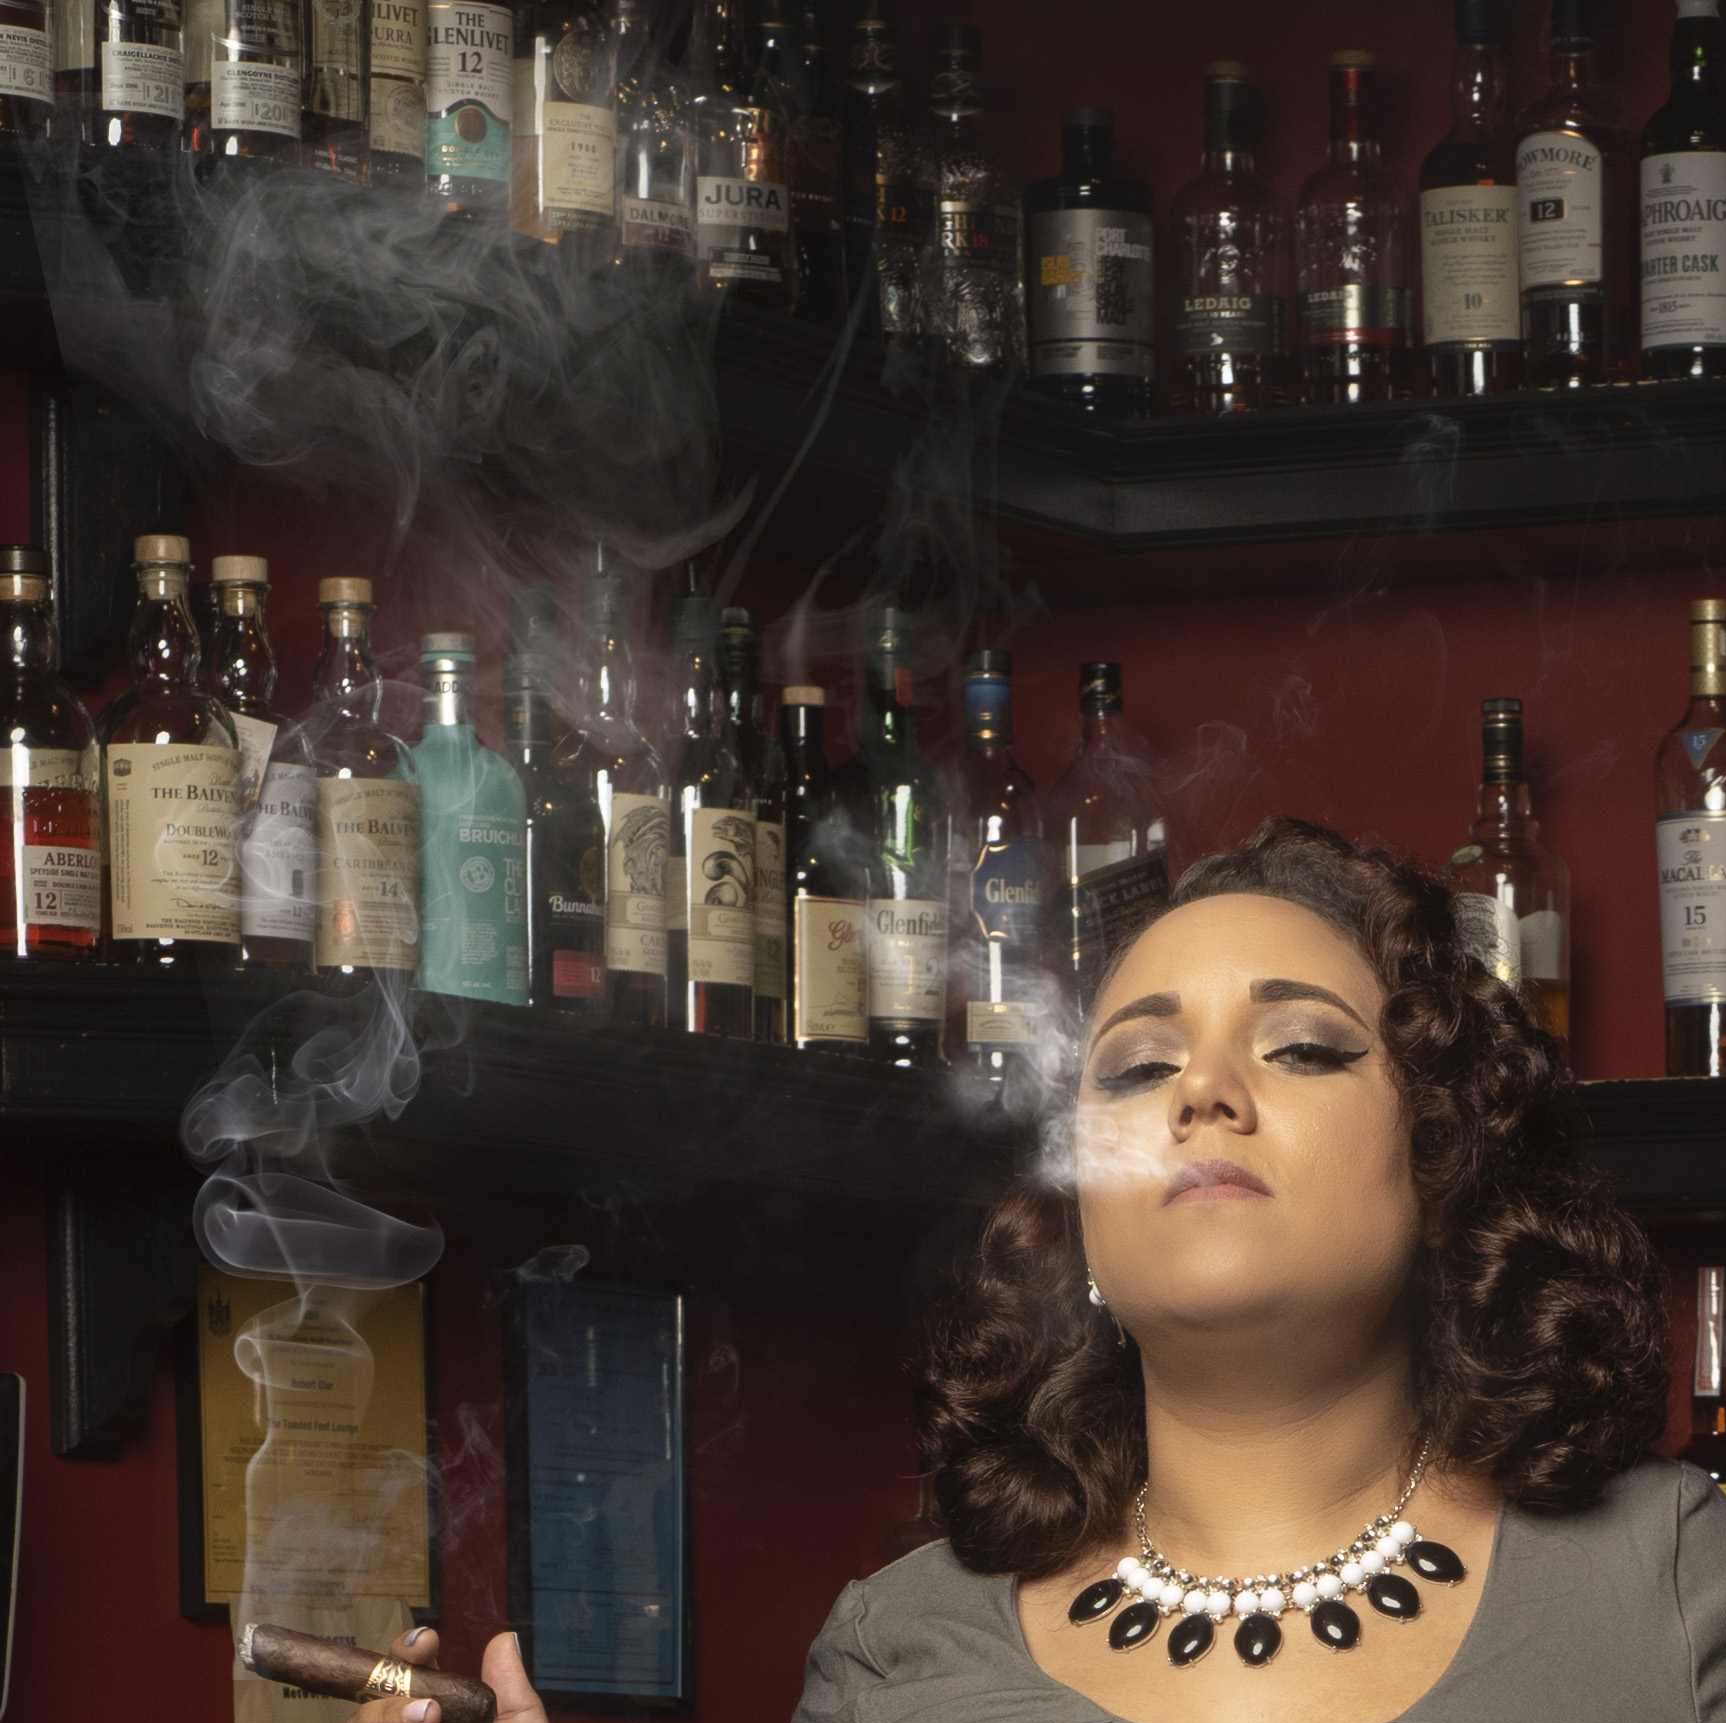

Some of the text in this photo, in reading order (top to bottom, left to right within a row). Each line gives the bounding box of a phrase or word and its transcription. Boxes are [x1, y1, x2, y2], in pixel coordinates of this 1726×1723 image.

[455, 11, 486, 28] THE
[112, 50, 167, 62] CRAIGELLACHIE
[457, 51, 483, 74] 12
[226, 69, 273, 79] GLENGOYNE
[260, 102, 282, 121] 20
[1518, 148, 1597, 172] OWMORE
[704, 184, 781, 210] JURA
[630, 206, 690, 230] DALMORE
[891, 206, 907, 222] 12
[1424, 208, 1509, 227] TALISKER
[1537, 202, 1556, 219] 12
[1682, 254, 1719, 272] CASK
[1184, 297, 1252, 312] LEDAIG
[1464, 294, 1483, 310] 10
[1693, 735, 1706, 747] 15
[182, 753, 204, 761] MALT
[151, 787, 182, 799] THE
[336, 822, 364, 833] THE
[201, 849, 219, 867] 12
[380, 881, 398, 897] 14
[34, 892, 57, 910] 12
[1684, 905, 1706, 925] 15
[314, 1420, 331, 1431] Foot
